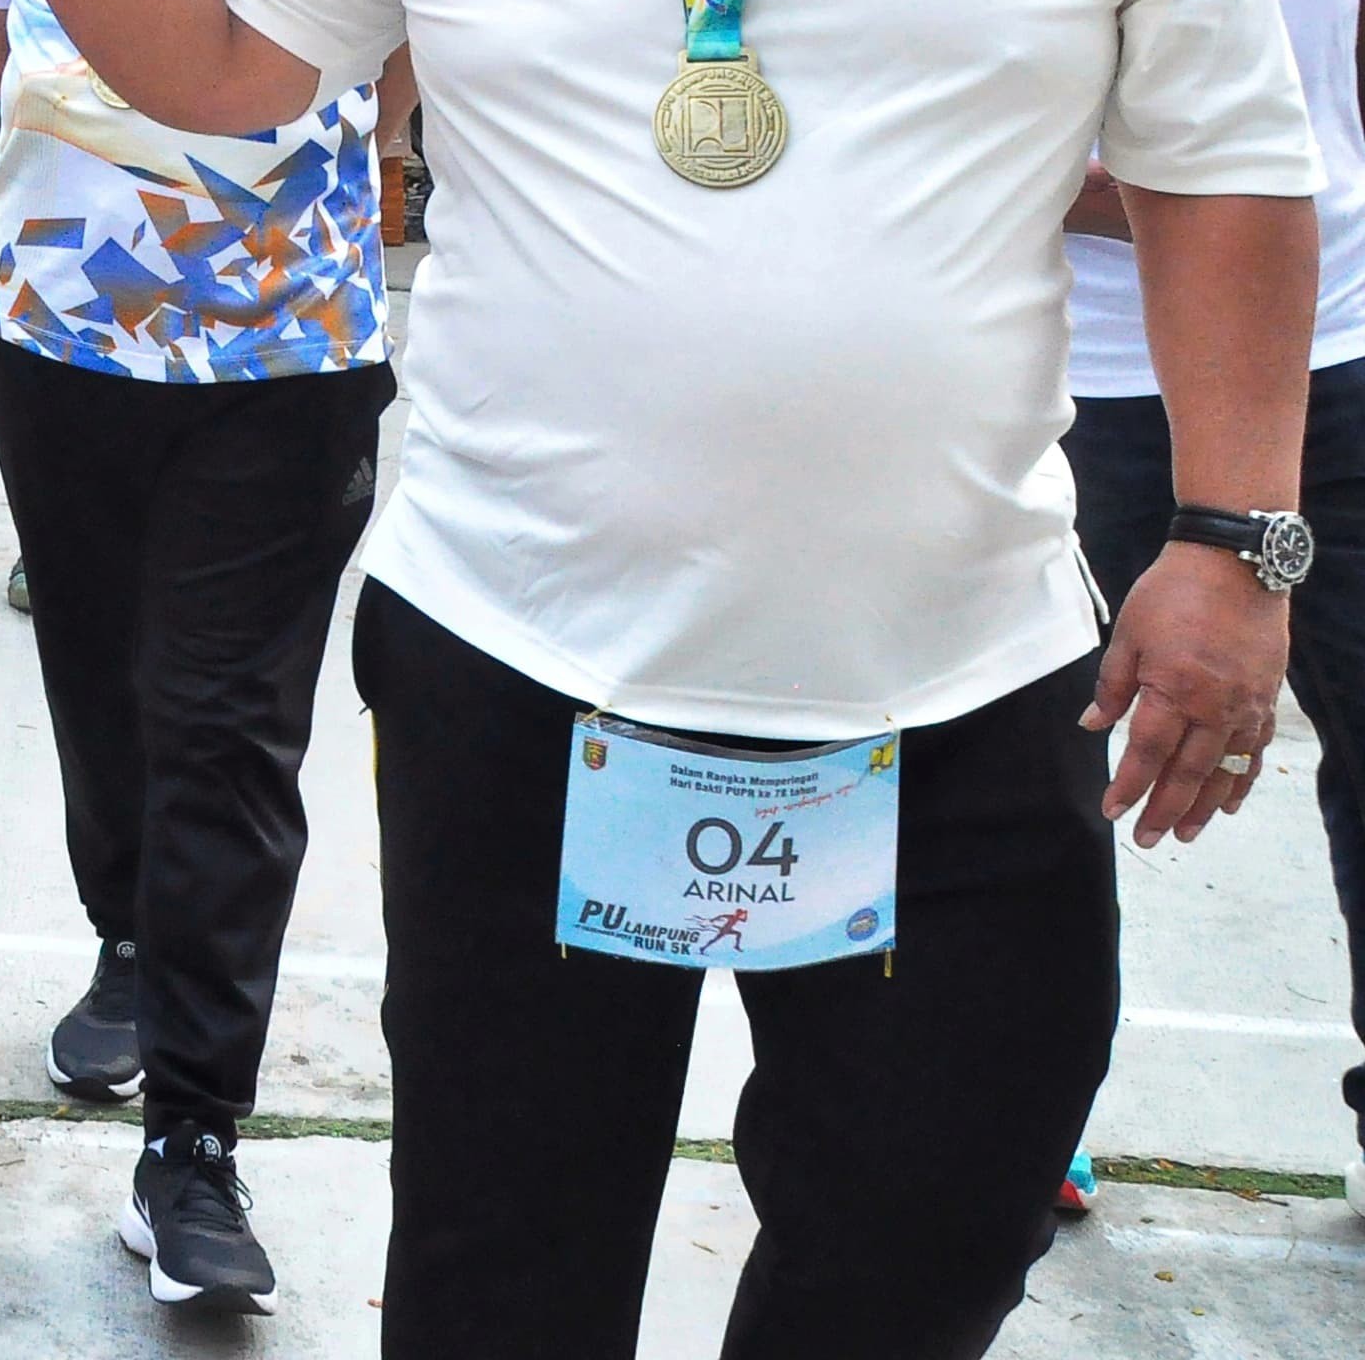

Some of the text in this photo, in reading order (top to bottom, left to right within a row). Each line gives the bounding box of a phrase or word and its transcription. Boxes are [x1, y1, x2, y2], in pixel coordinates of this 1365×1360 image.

[706, 771, 746, 786] Rangka
[686, 816, 799, 877] 04
[682, 878, 796, 905] ARINAL
[579, 898, 628, 931] PU
[624, 921, 701, 944] LAMPUNG
[633, 936, 691, 956] RUN 5K
